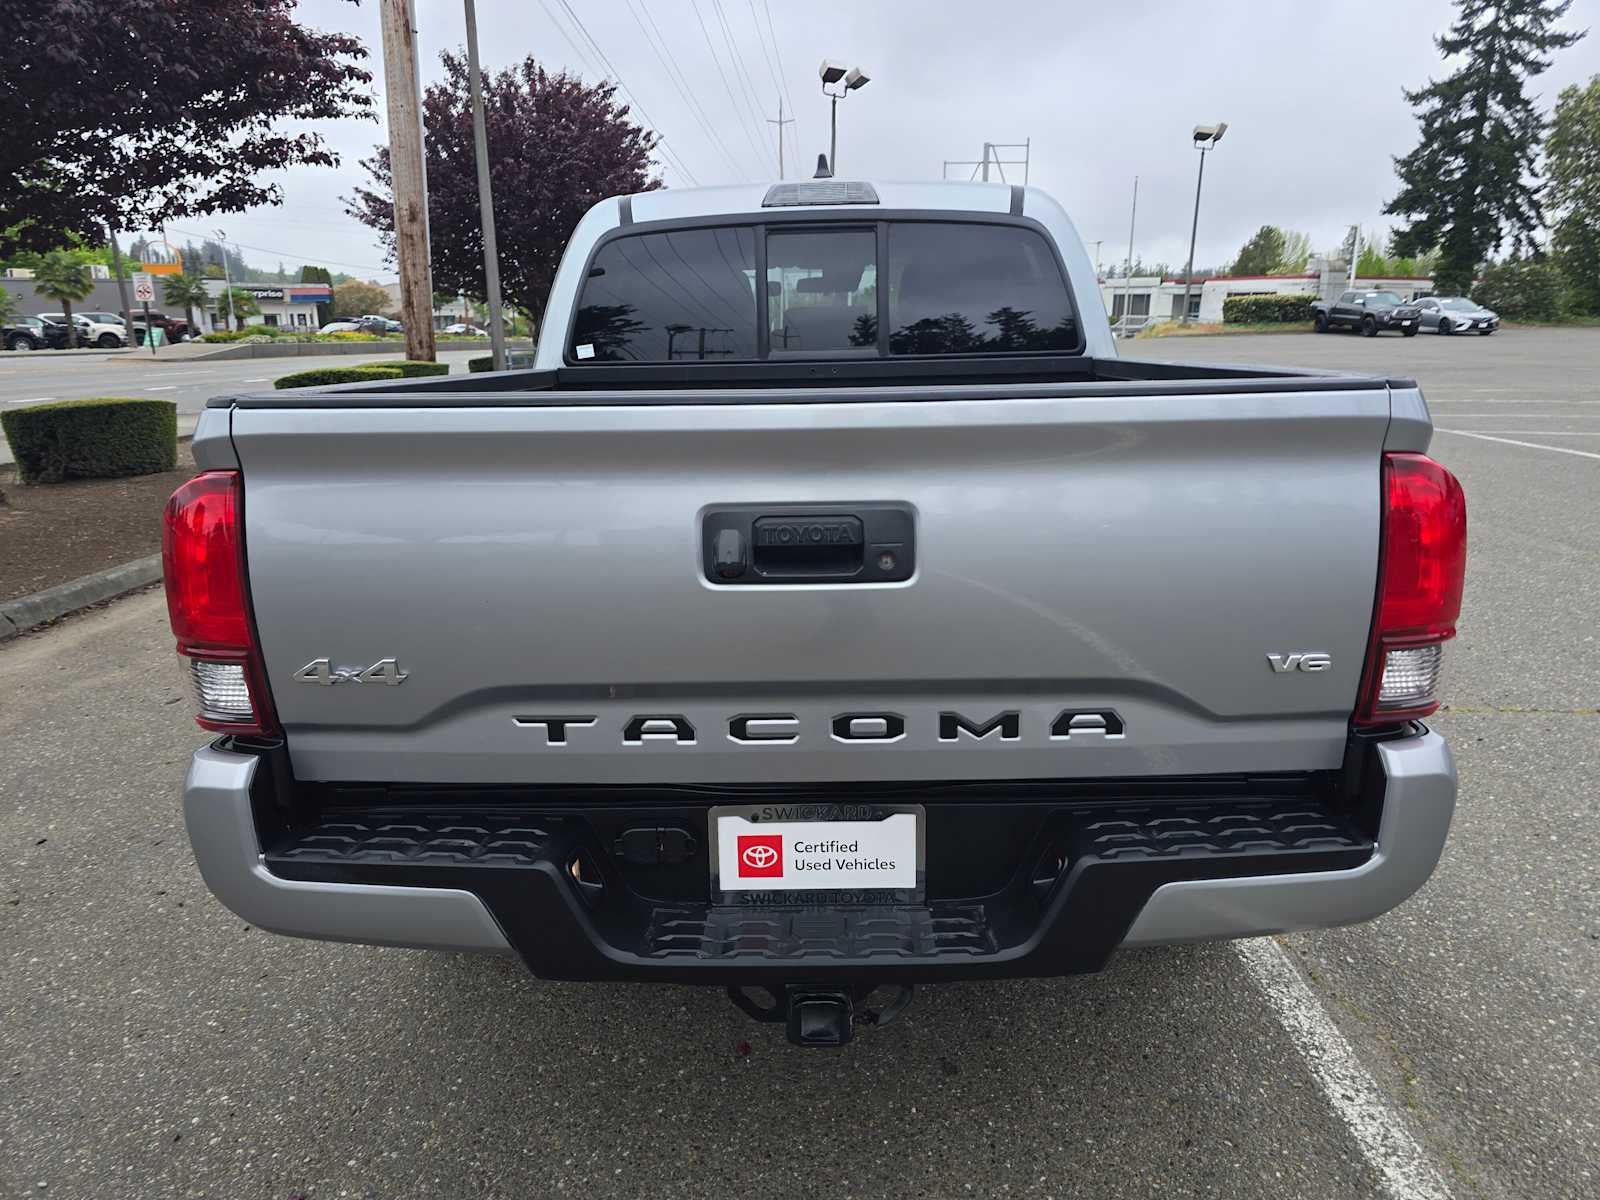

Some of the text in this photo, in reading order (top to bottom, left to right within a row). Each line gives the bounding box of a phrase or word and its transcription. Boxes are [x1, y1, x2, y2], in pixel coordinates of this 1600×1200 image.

[762, 524, 855, 545] TOYOTA
[1267, 653, 1332, 673] V6
[512, 707, 1127, 747] TACOMA
[762, 805, 873, 821] SWICKARD
[794, 840, 858, 854] Certified
[794, 857, 896, 871] Used Vehicles
[742, 891, 897, 905] SWICKARD TOYOTA
